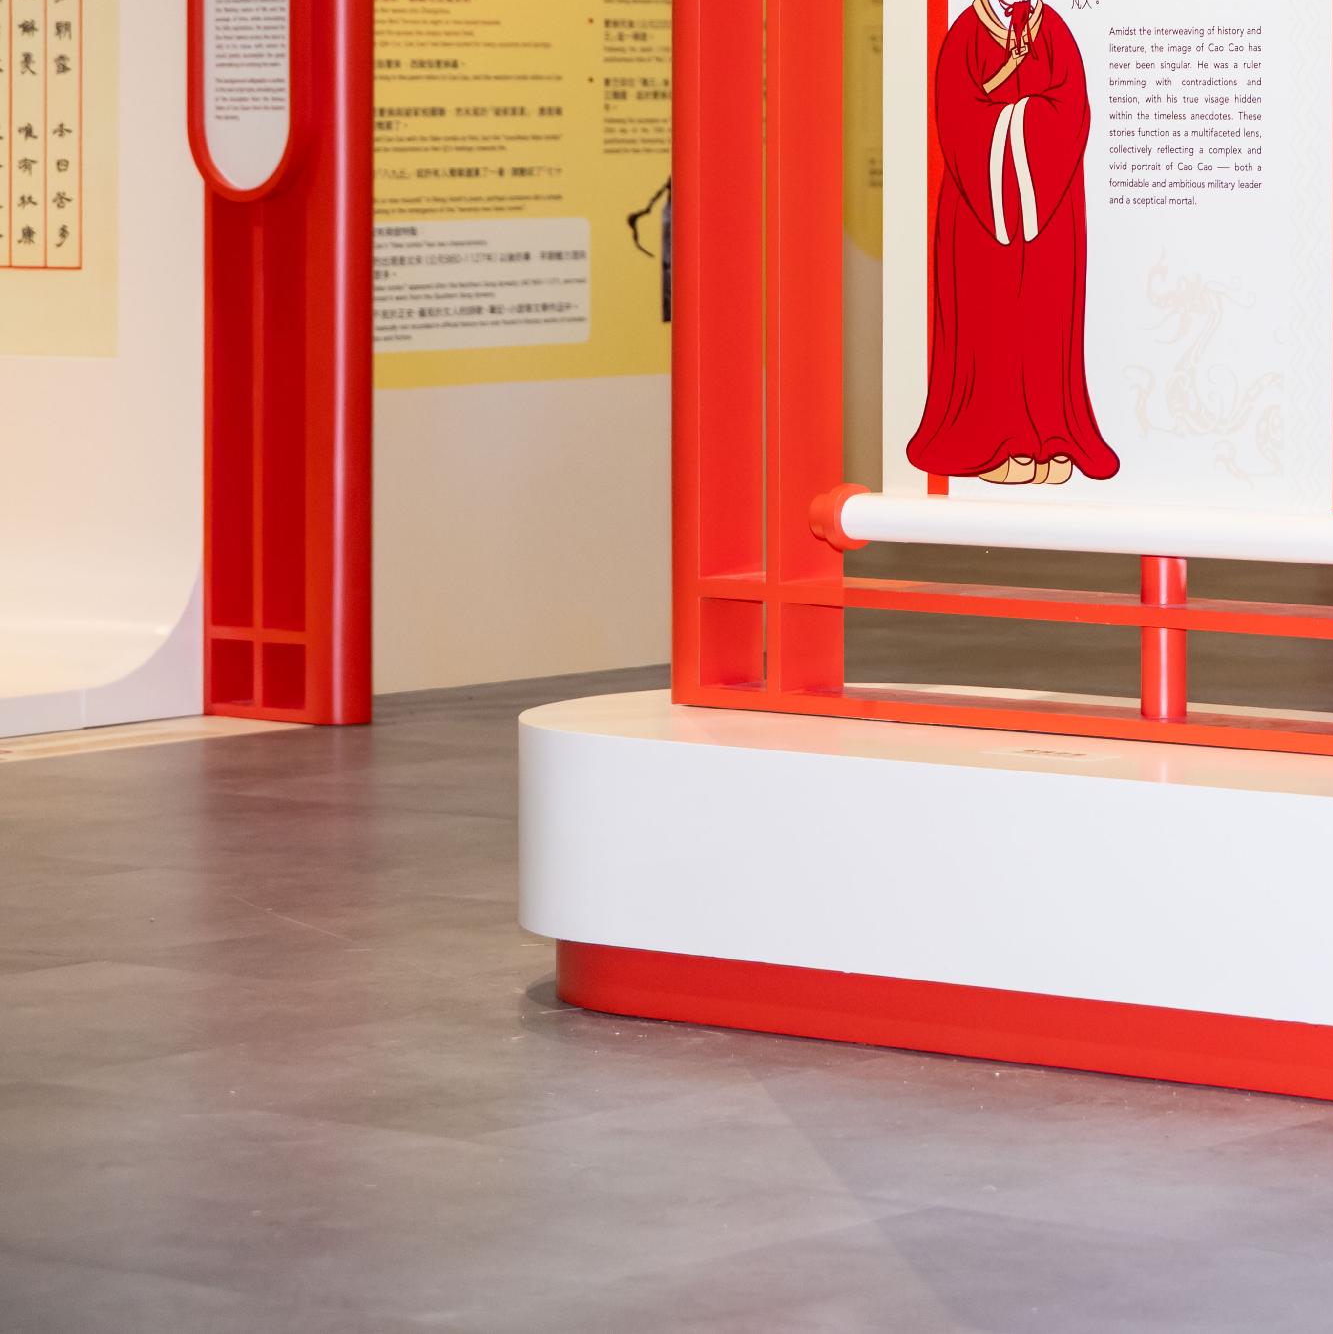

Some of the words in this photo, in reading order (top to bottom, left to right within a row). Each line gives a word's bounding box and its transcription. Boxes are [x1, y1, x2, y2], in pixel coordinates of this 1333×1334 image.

[1109, 27, 1136, 36] Amidst
[1139, 27, 1152, 36] the
[1154, 27, 1205, 39] interweaving
[1217, 27, 1244, 39] history
[1247, 27, 1262, 36] and
[1109, 44, 1146, 55] literature,
[1151, 44, 1164, 53] the
[1168, 44, 1191, 55] image
[1208, 44, 1224, 53] Cao
[1229, 44, 1244, 53] Cao
[1249, 44, 1261, 53] has
[1136, 60, 1155, 70] been
[1161, 60, 1191, 72] singular.
[1244, 60, 1261, 70] ruler
[1109, 78, 1148, 89] brimming
[1155, 78, 1171, 87] with
[1182, 78, 1239, 87] contradictions
[1247, 78, 1261, 87] and
[1109, 95, 1140, 107] tension,
[1145, 95, 1162, 104] with
[1166, 95, 1177, 104] his
[1183, 95, 1199, 104] true
[1204, 95, 1230, 107] visage
[1234, 95, 1262, 104] hidden
[1109, 112, 1133, 121] within
[1137, 112, 1150, 121] the
[1154, 112, 1186, 121] timeless
[1189, 112, 1233, 121] anecdotes.
[1238, 112, 1263, 121] These
[1109, 128, 1135, 138] stories
[1137, 128, 1170, 138] function
[1191, 128, 1241, 138] multifaceted
[1243, 128, 1262, 140] lens,
[1109, 146, 1152, 157] collectively
[1157, 146, 1194, 157] reflecting
[1208, 146, 1242, 157] complex
[1247, 146, 1261, 155] and
[1109, 163, 1127, 172] vivid
[1131, 163, 1161, 174] portrait
[1177, 163, 1193, 172] Cao
[1197, 163, 1213, 172] Cao
[1234, 163, 1253, 172] both
[1109, 179, 1149, 189] formidable
[1152, 179, 1166, 189] and
[1168, 179, 1205, 189] ambitious
[1207, 179, 1235, 191] military
[1238, 179, 1262, 189] leader
[1109, 196, 1124, 206] and
[1132, 196, 1167, 208] sceptical
[1169, 196, 1197, 206] mortal.
